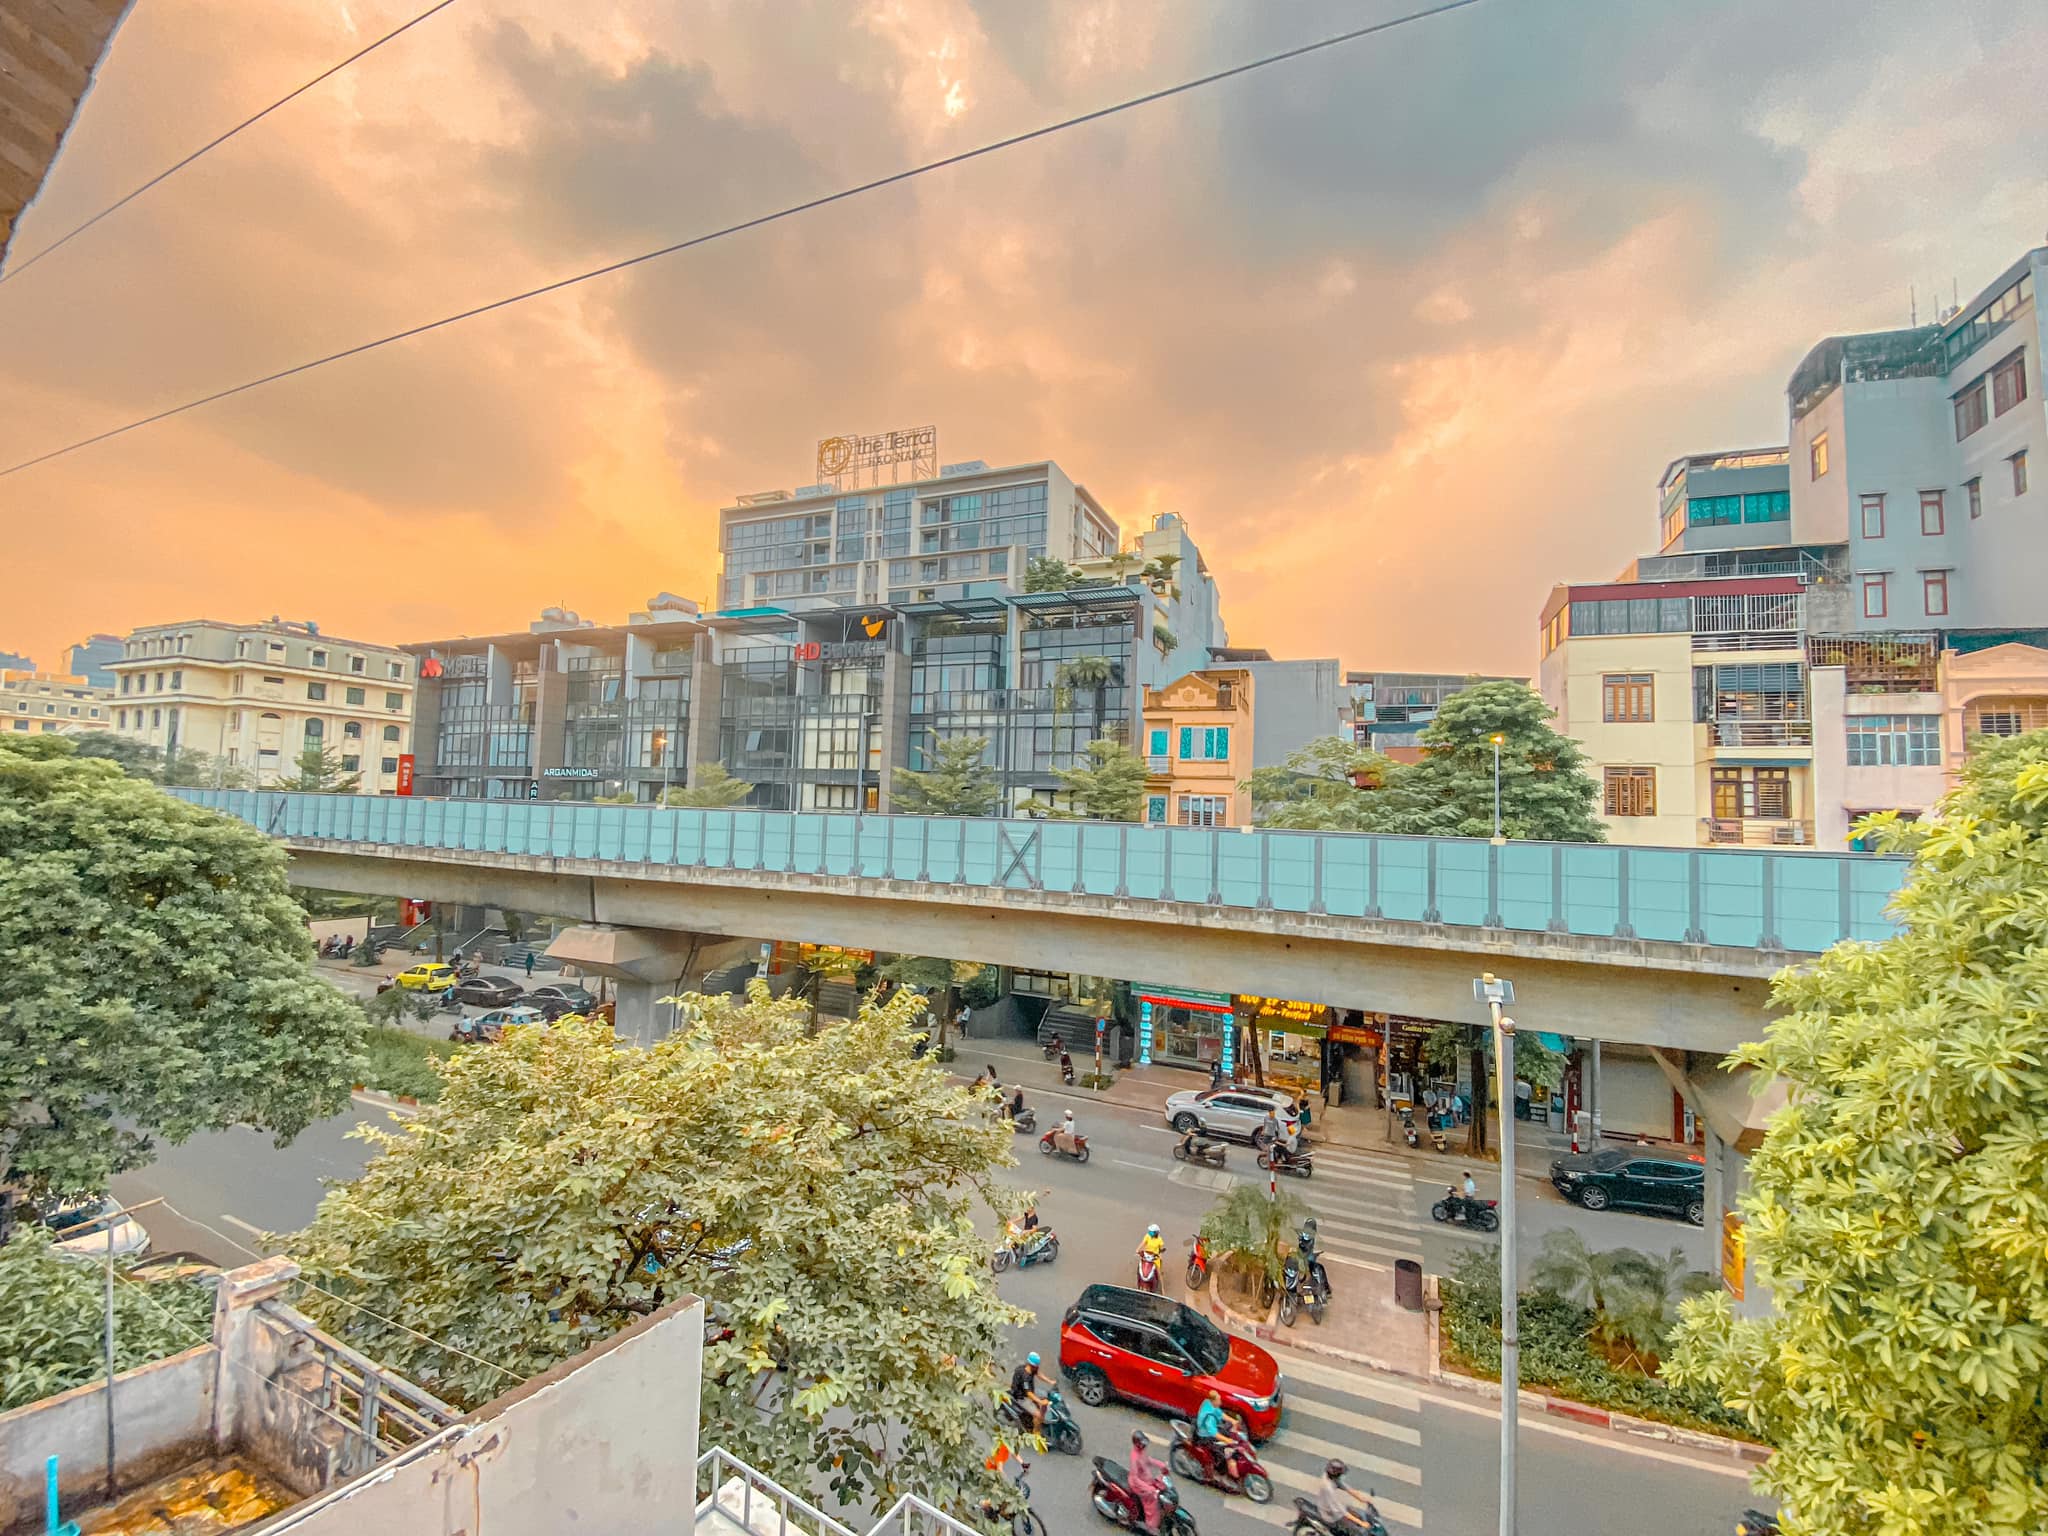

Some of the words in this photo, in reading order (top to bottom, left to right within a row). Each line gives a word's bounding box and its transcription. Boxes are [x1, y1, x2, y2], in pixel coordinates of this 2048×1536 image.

[857, 437, 884, 455] the
[887, 431, 932, 450] Terra
[543, 768, 599, 777] ARGANMIDAS
